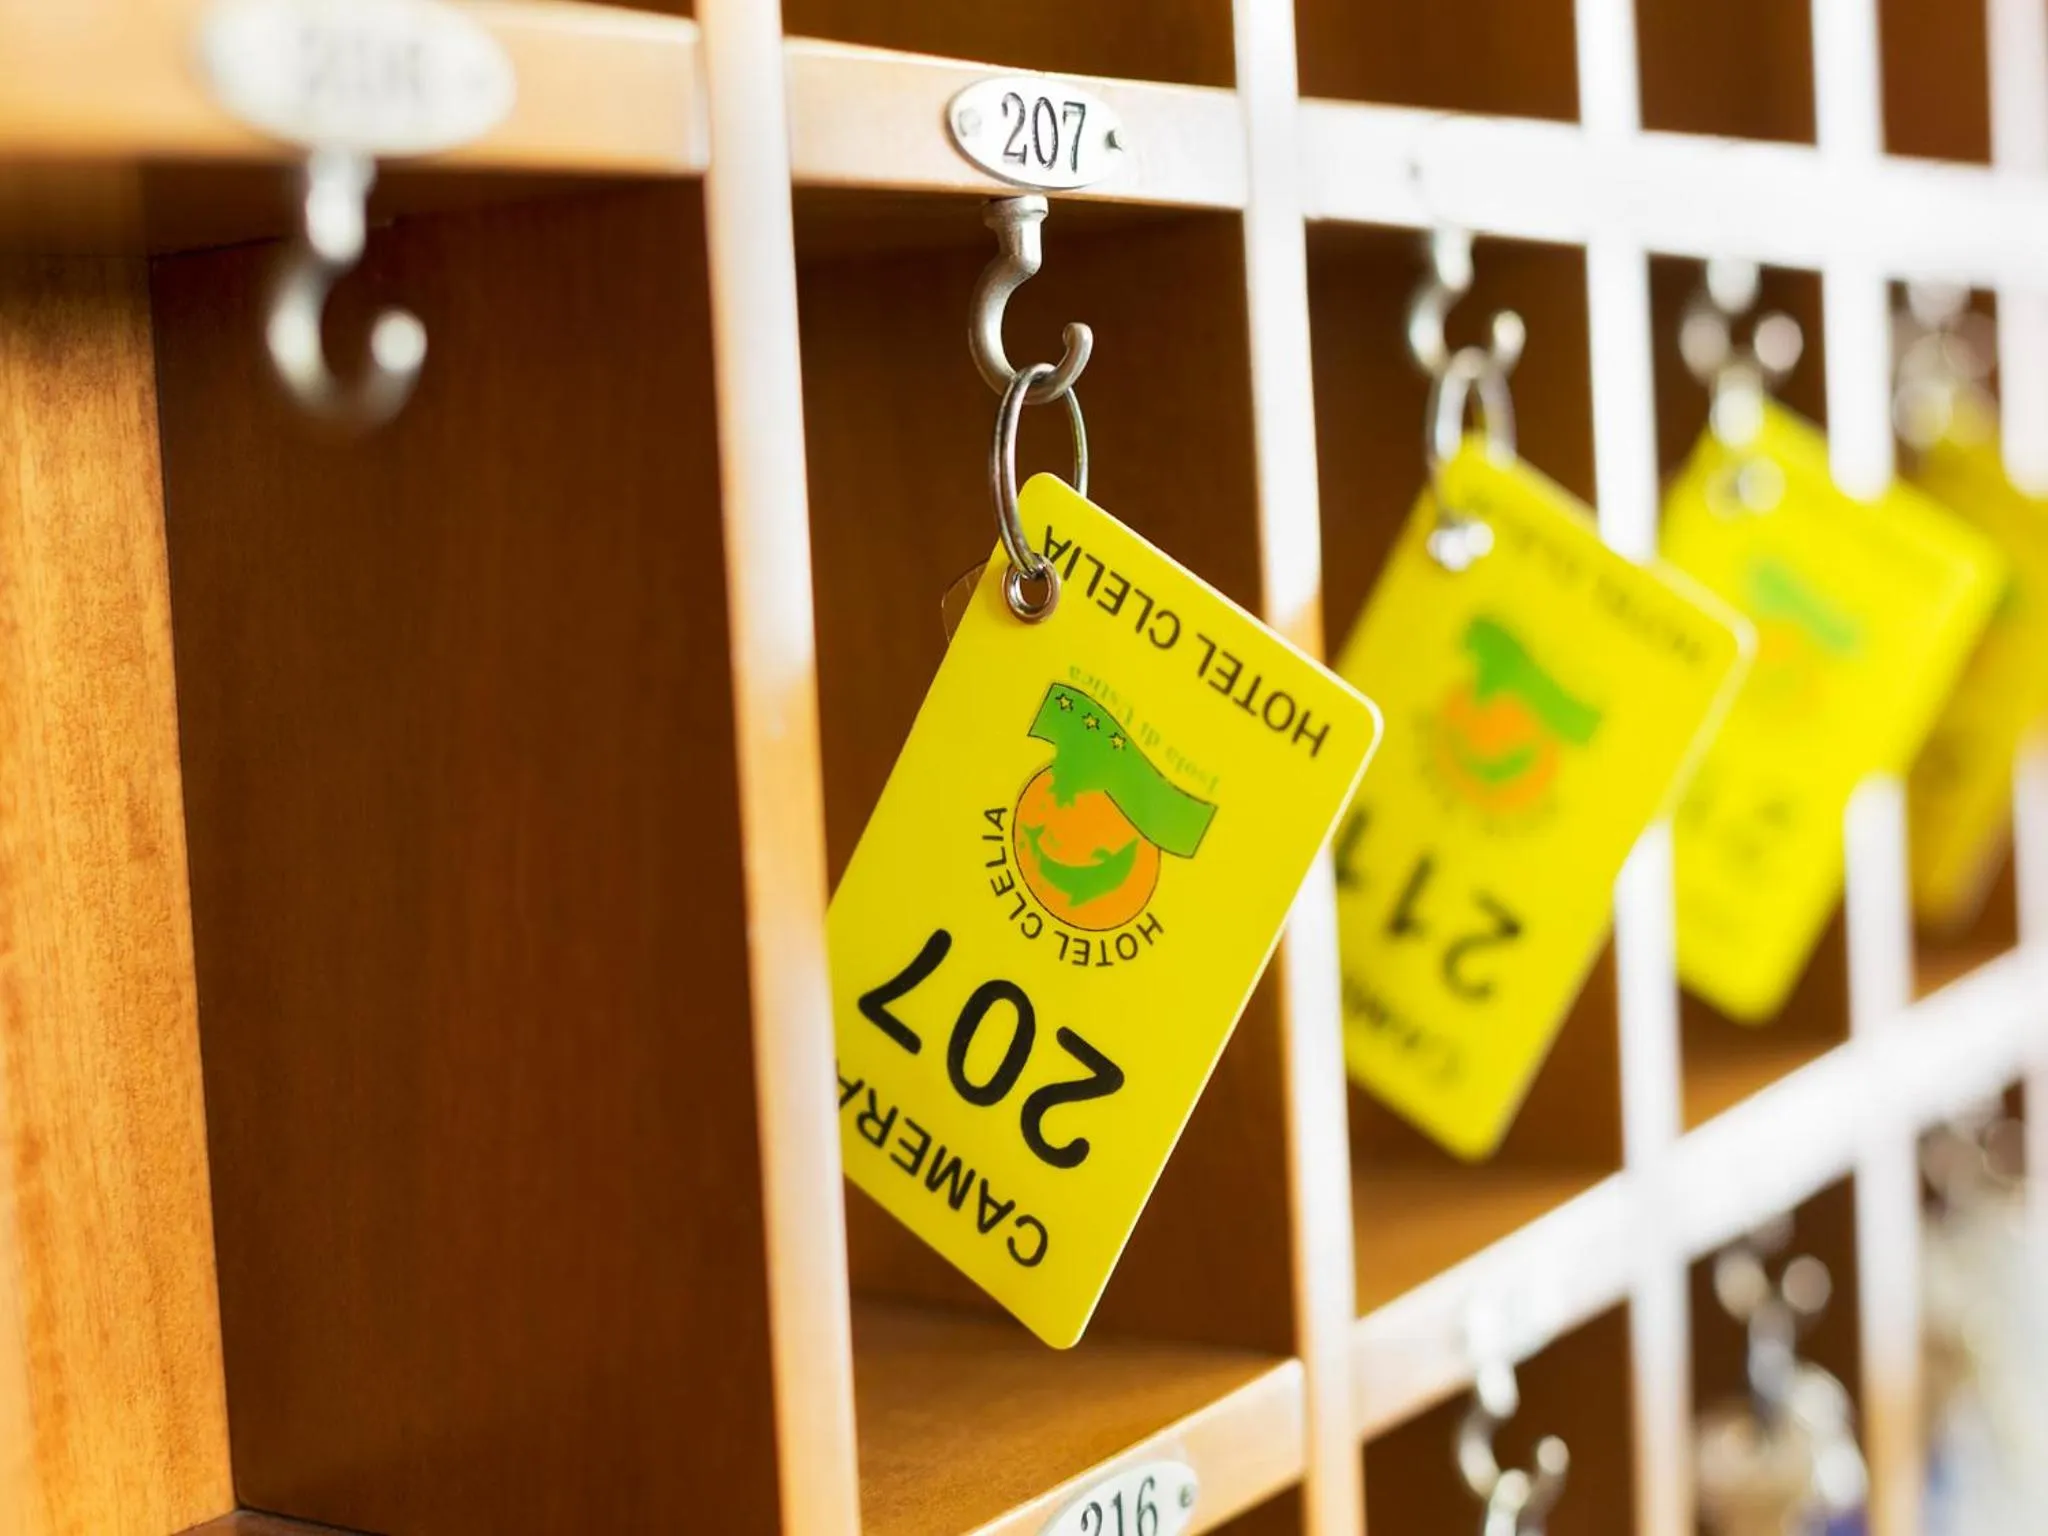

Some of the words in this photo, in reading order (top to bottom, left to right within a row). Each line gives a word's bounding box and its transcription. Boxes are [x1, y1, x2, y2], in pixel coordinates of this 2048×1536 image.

[1001, 91, 1087, 174] 207
[1044, 524, 1182, 651] CLELIA
[1068, 665, 1135, 726] Ustica
[1140, 721, 1162, 748] di
[1195, 630, 1332, 760] HOTEL
[1165, 746, 1219, 795] Isola
[981, 806, 1044, 940] CLELIA
[1056, 911, 1165, 968] HOTEL
[857, 928, 1125, 1169] 207
